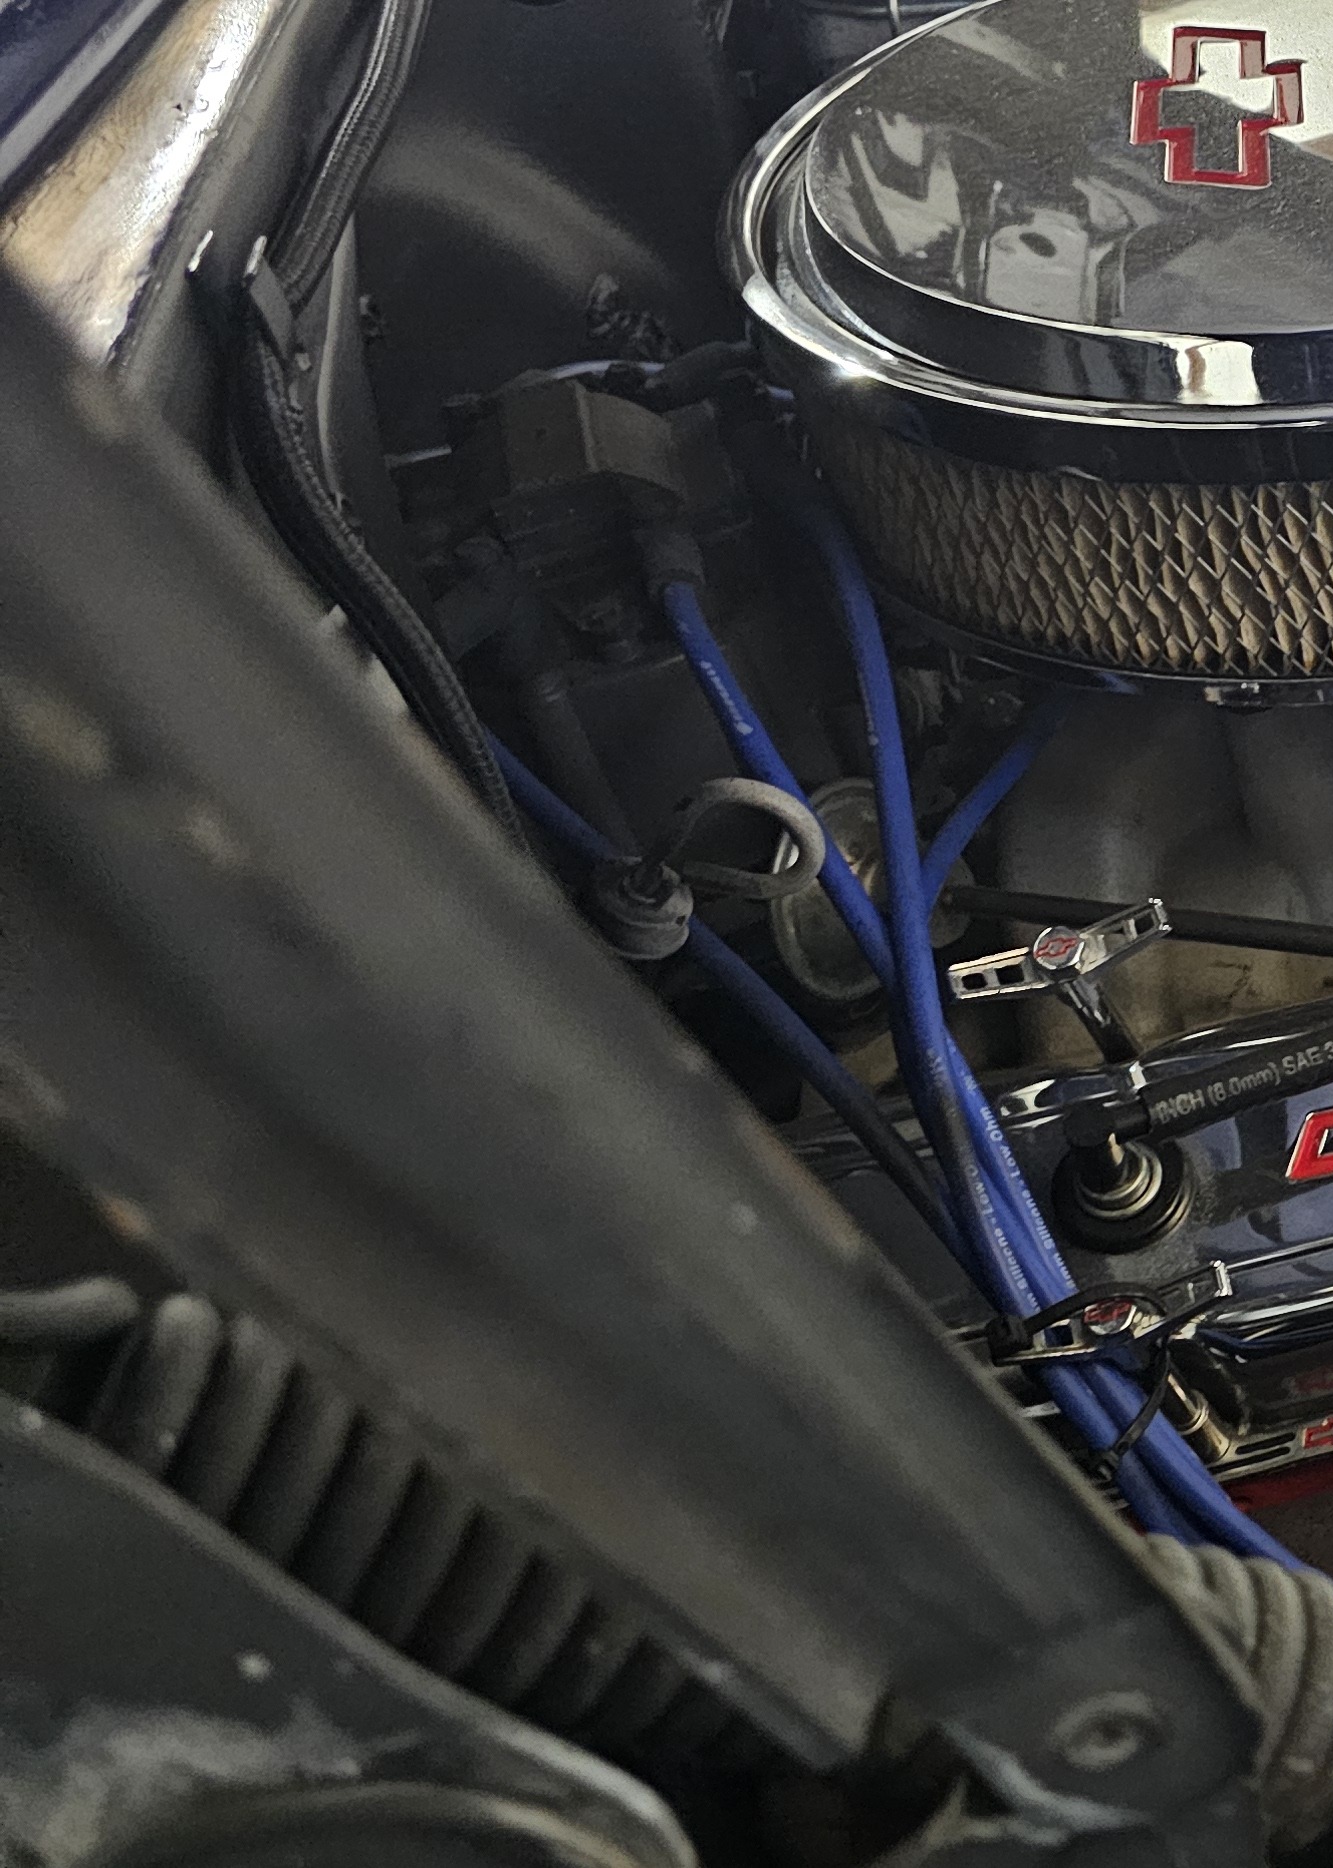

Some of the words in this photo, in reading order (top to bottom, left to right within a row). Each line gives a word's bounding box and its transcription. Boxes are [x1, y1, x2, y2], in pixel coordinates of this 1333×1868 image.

[1278, 1043, 1325, 1077] SAE
[974, 1103, 1006, 1145] Ohm
[994, 1140, 1023, 1178] Low
[965, 1174, 998, 1217] Low
